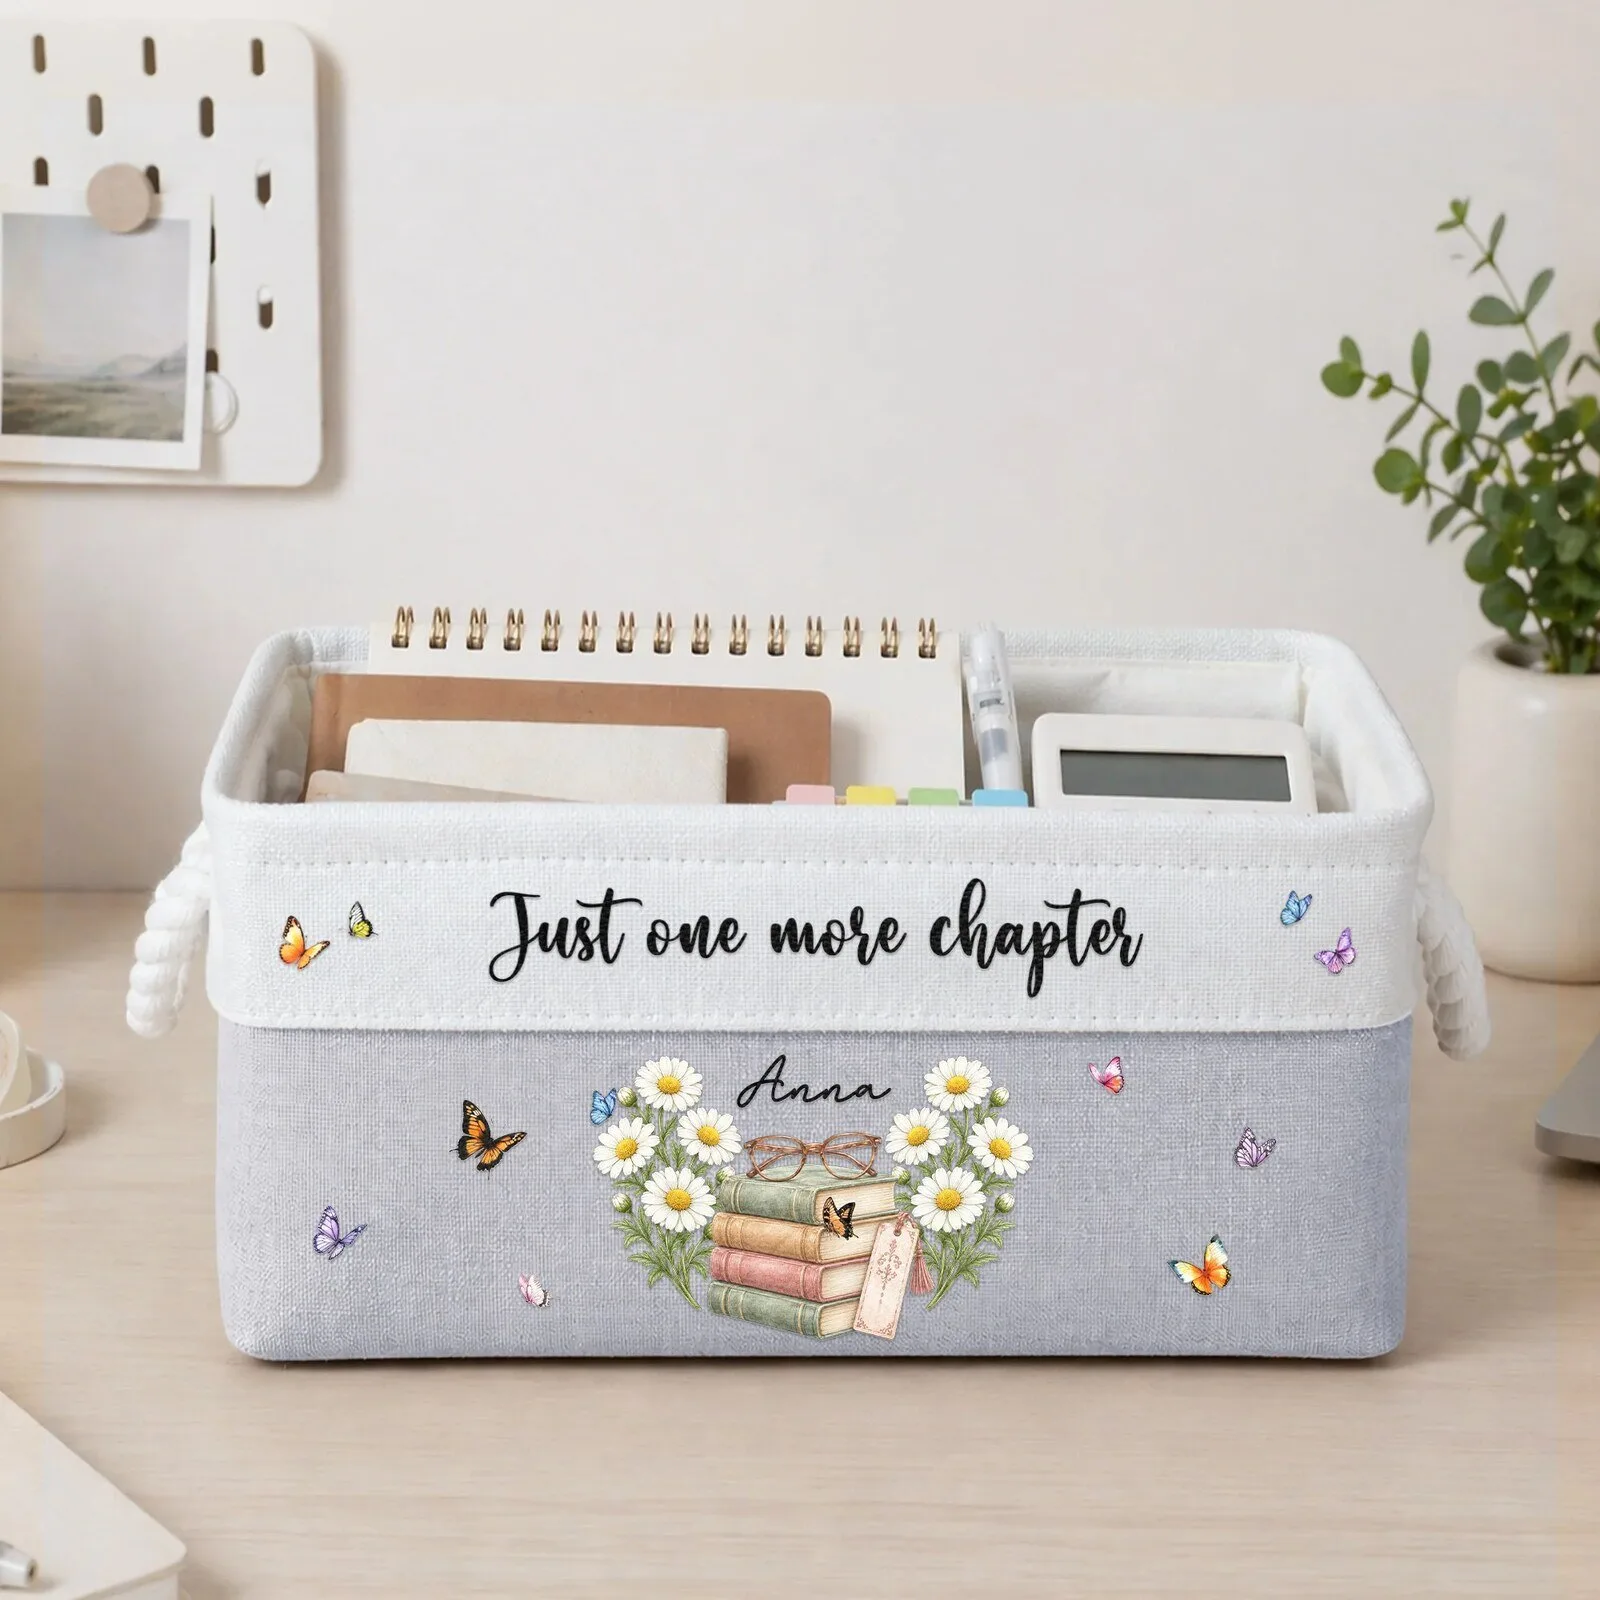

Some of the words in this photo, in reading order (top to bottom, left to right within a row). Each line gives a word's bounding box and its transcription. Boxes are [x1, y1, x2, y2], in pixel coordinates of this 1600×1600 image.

[488, 886, 643, 983] Just
[646, 915, 748, 959] one
[770, 905, 907, 966] more
[929, 877, 1144, 999] chapter
[736, 1054, 892, 1109] Anna
